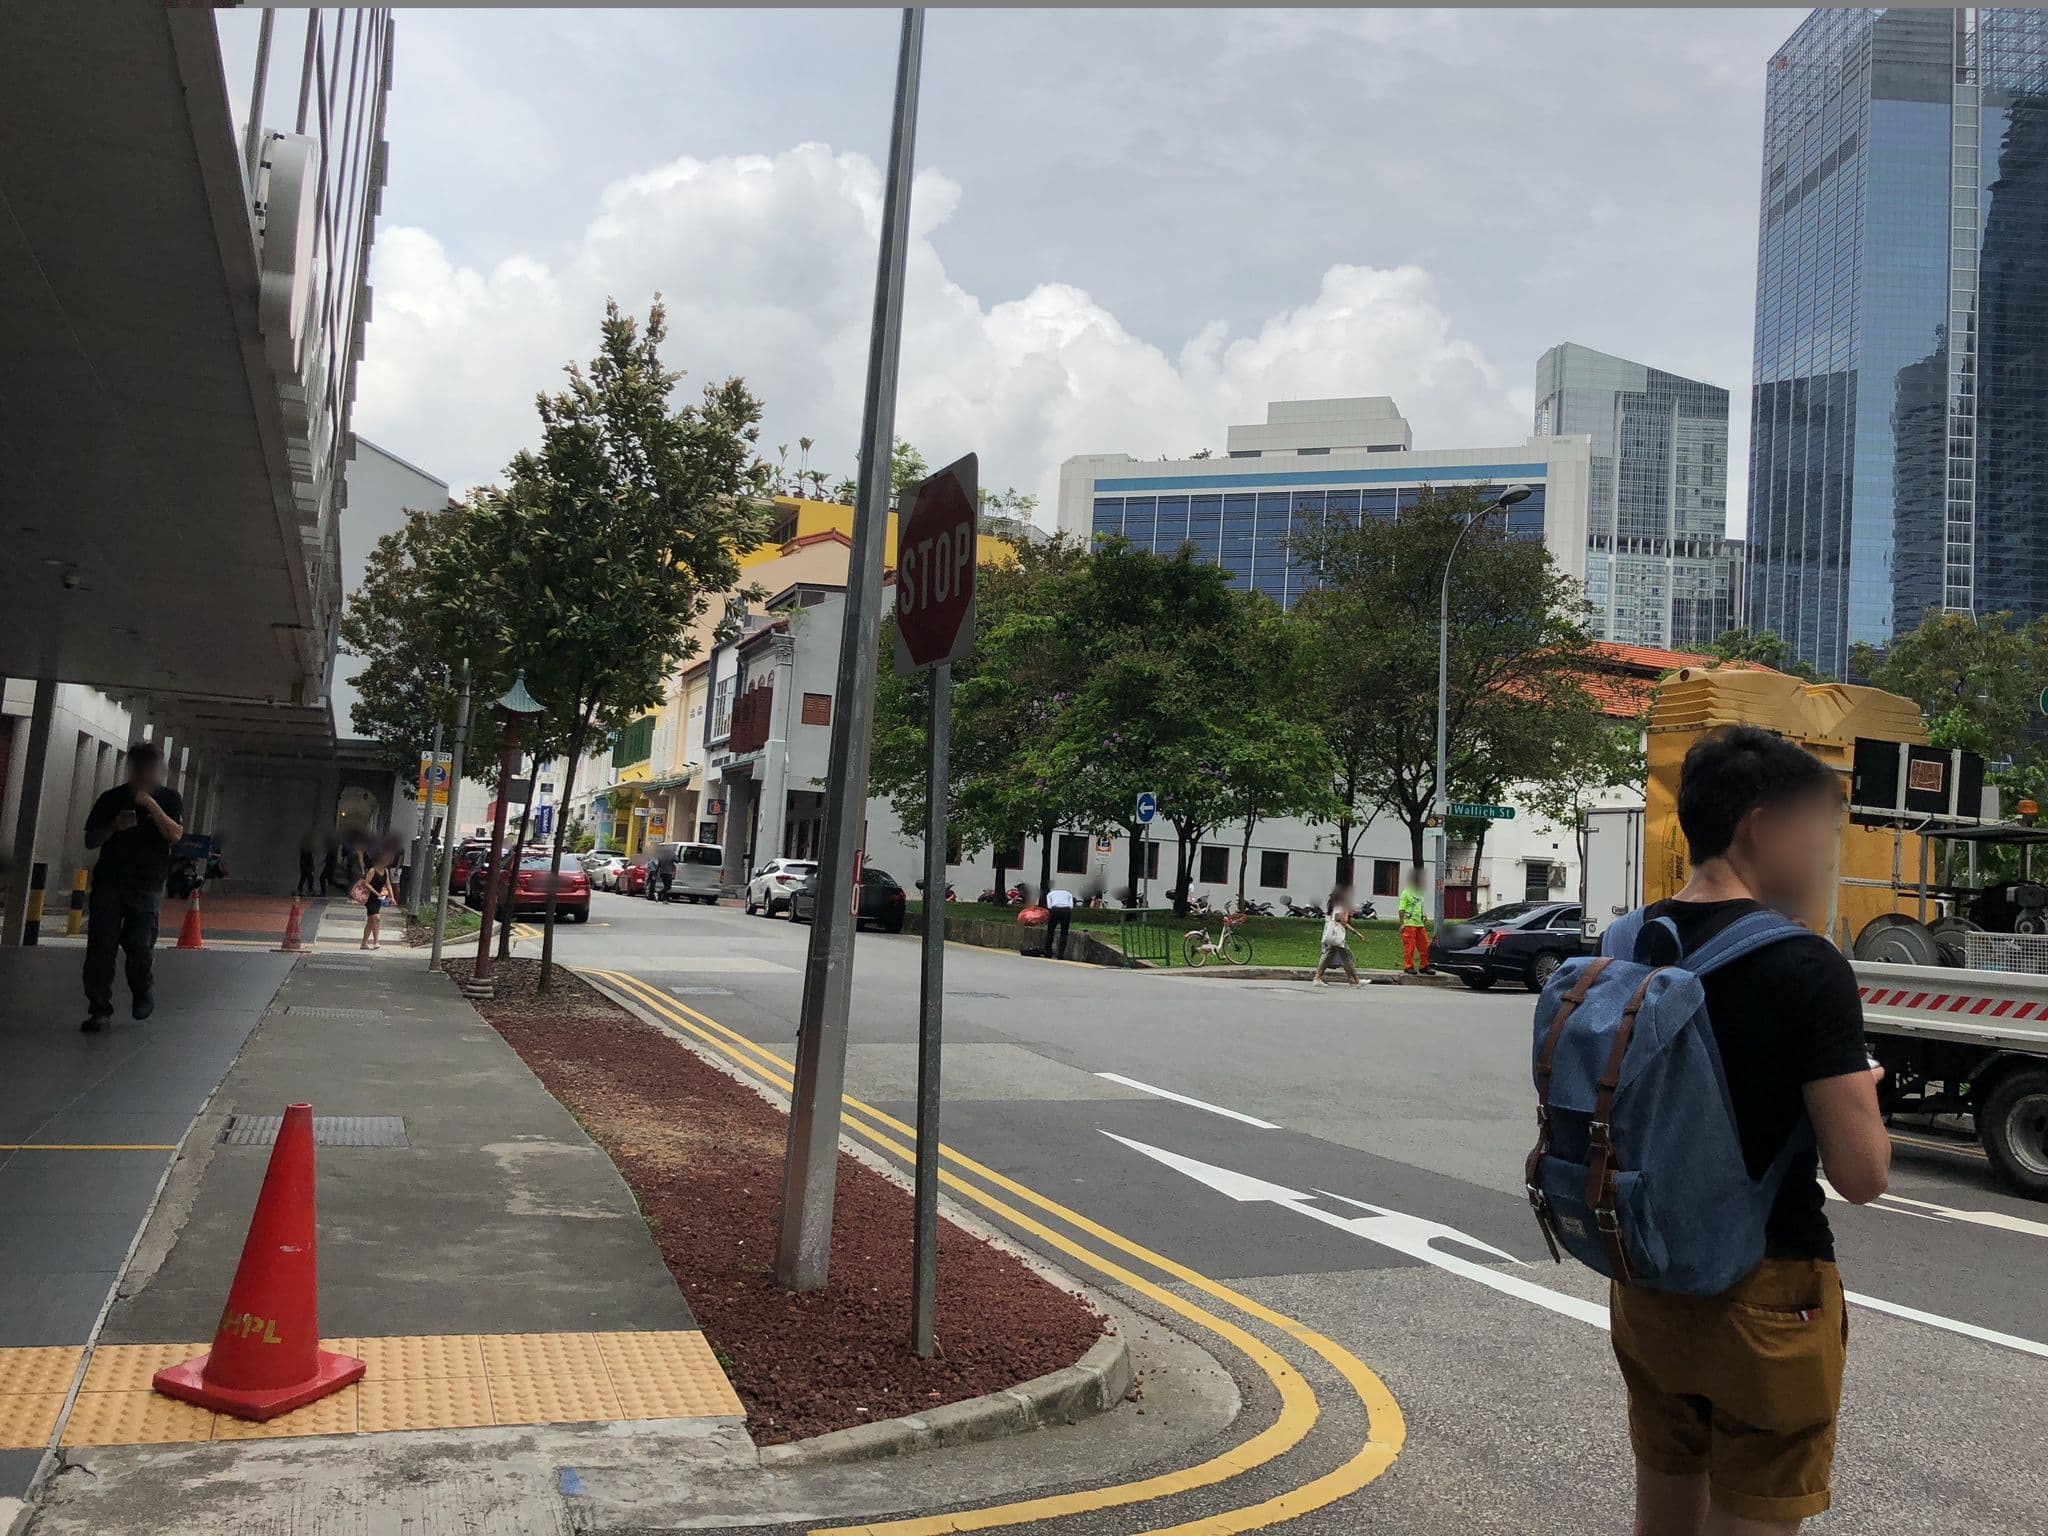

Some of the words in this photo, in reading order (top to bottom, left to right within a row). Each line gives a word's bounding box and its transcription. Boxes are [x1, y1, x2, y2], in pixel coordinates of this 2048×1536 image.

[901, 522, 970, 615] STOP
[1454, 805, 1495, 817] Wallich
[1500, 808, 1510, 817] St
